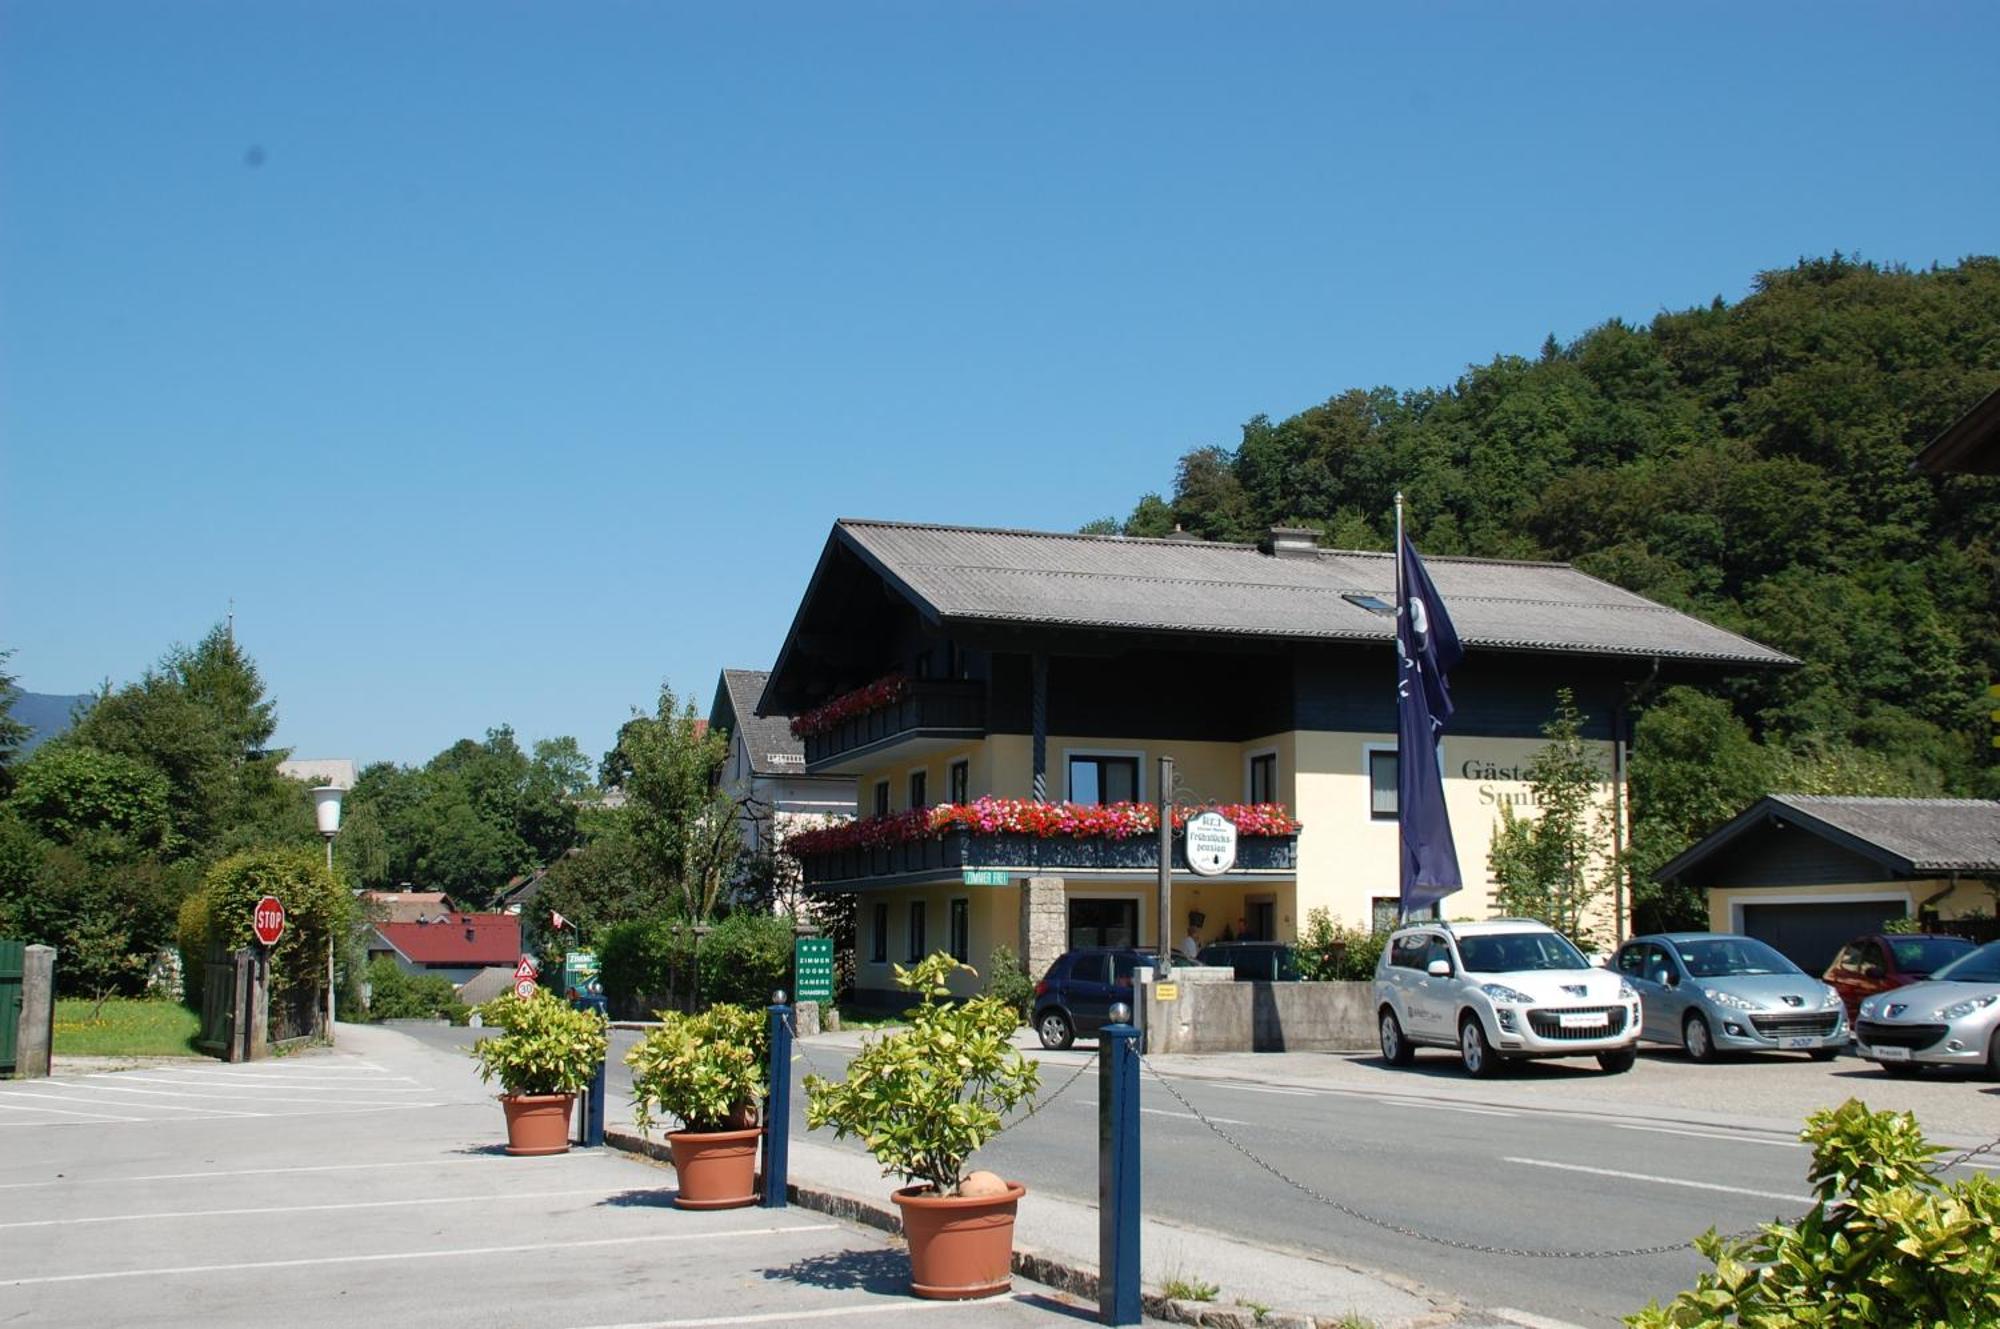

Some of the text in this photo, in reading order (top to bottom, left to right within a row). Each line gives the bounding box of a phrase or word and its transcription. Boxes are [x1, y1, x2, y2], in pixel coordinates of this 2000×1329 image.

[258, 910, 282, 929] STOP
[519, 983, 533, 994] 30
[1791, 1037, 1813, 1047] 207
